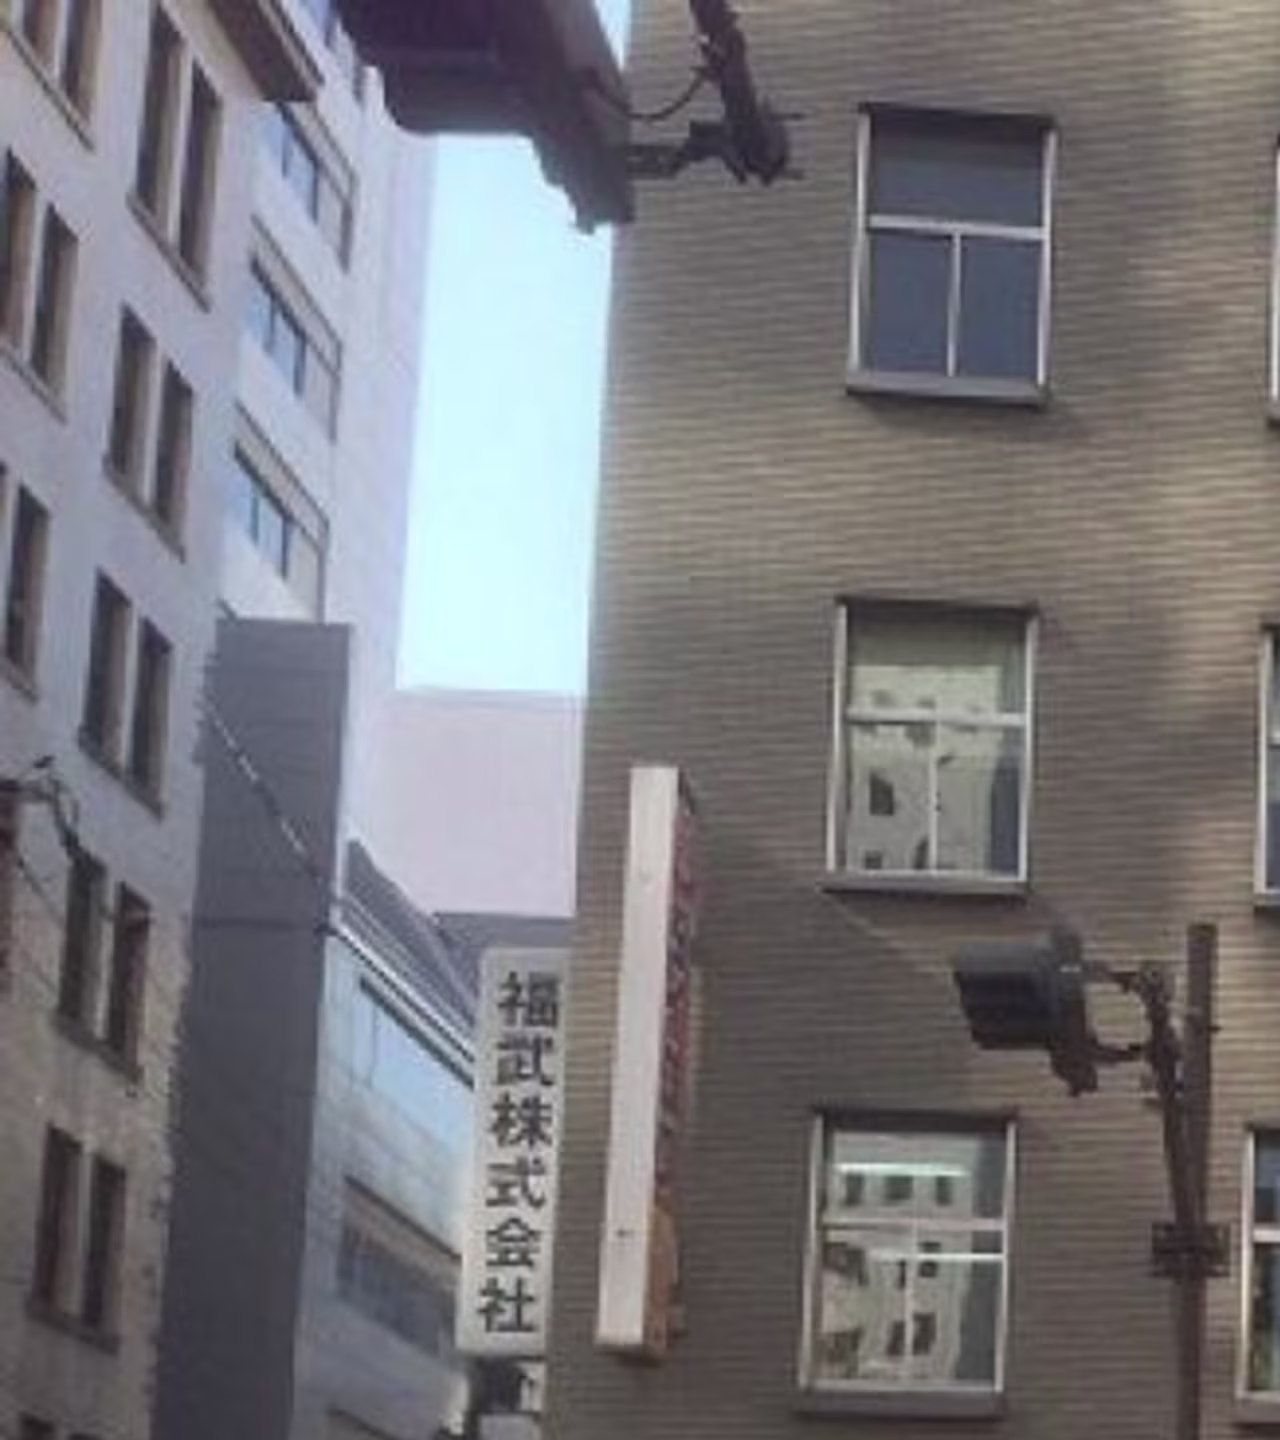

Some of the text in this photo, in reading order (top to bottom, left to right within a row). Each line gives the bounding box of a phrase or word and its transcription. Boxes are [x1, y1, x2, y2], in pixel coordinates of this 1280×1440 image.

[475, 970, 560, 1335] 福武株式会社
